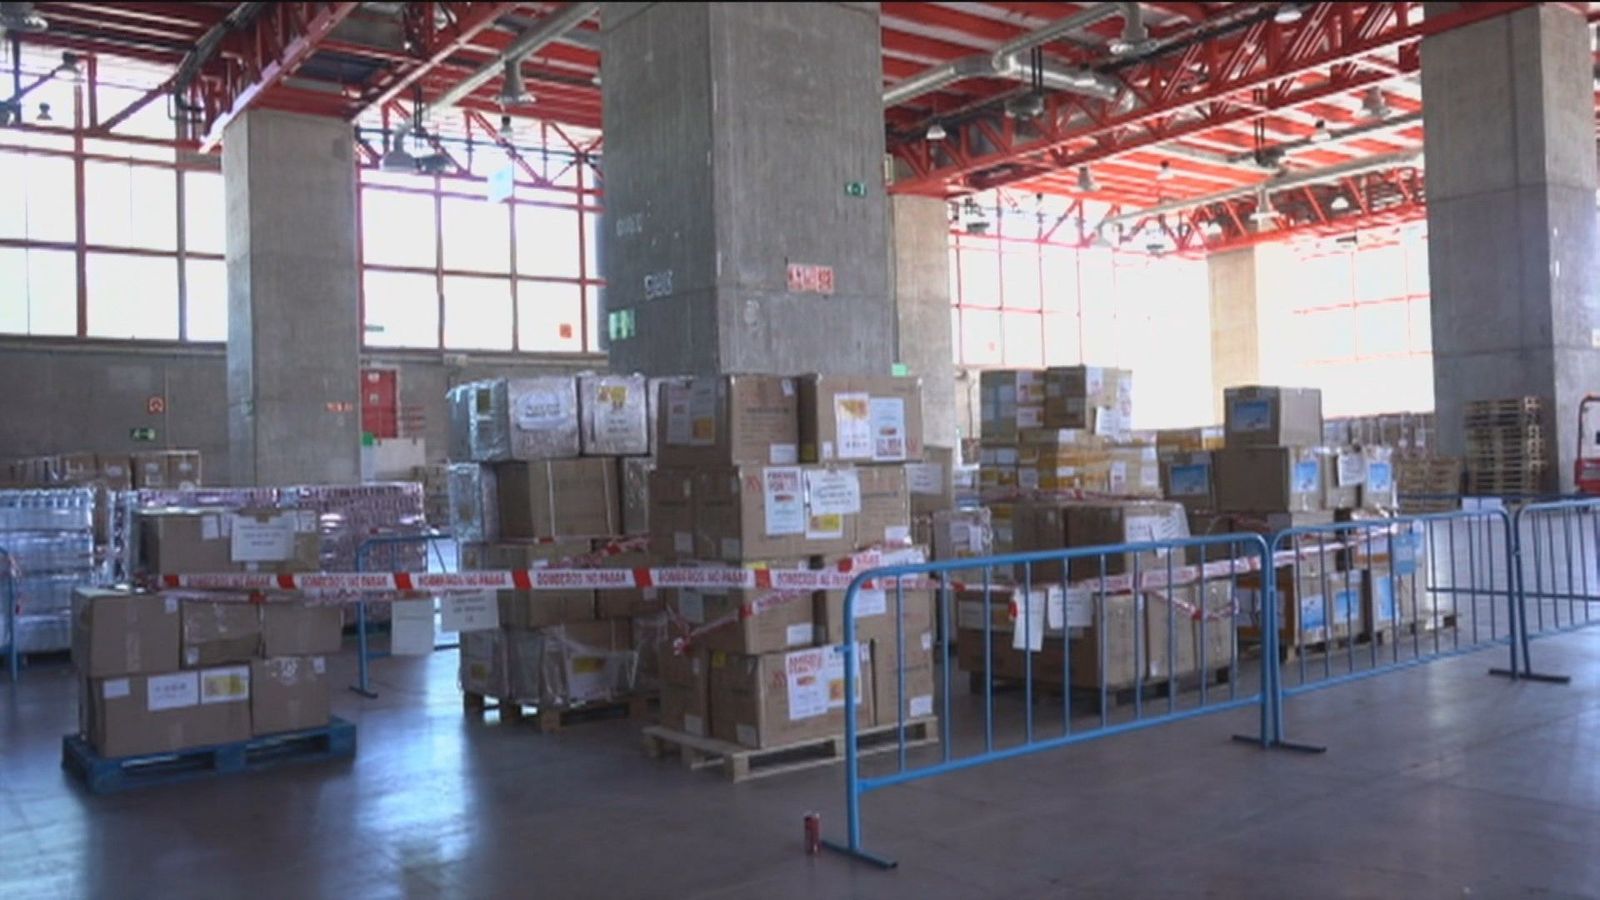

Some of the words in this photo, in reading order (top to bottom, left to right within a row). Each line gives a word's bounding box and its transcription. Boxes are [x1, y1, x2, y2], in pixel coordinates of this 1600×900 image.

[537, 572, 582, 586] BOMBEROS
[601, 571, 626, 583] PASAR
[658, 570, 704, 584] BOMBEROS
[721, 570, 748, 583] PASAR
